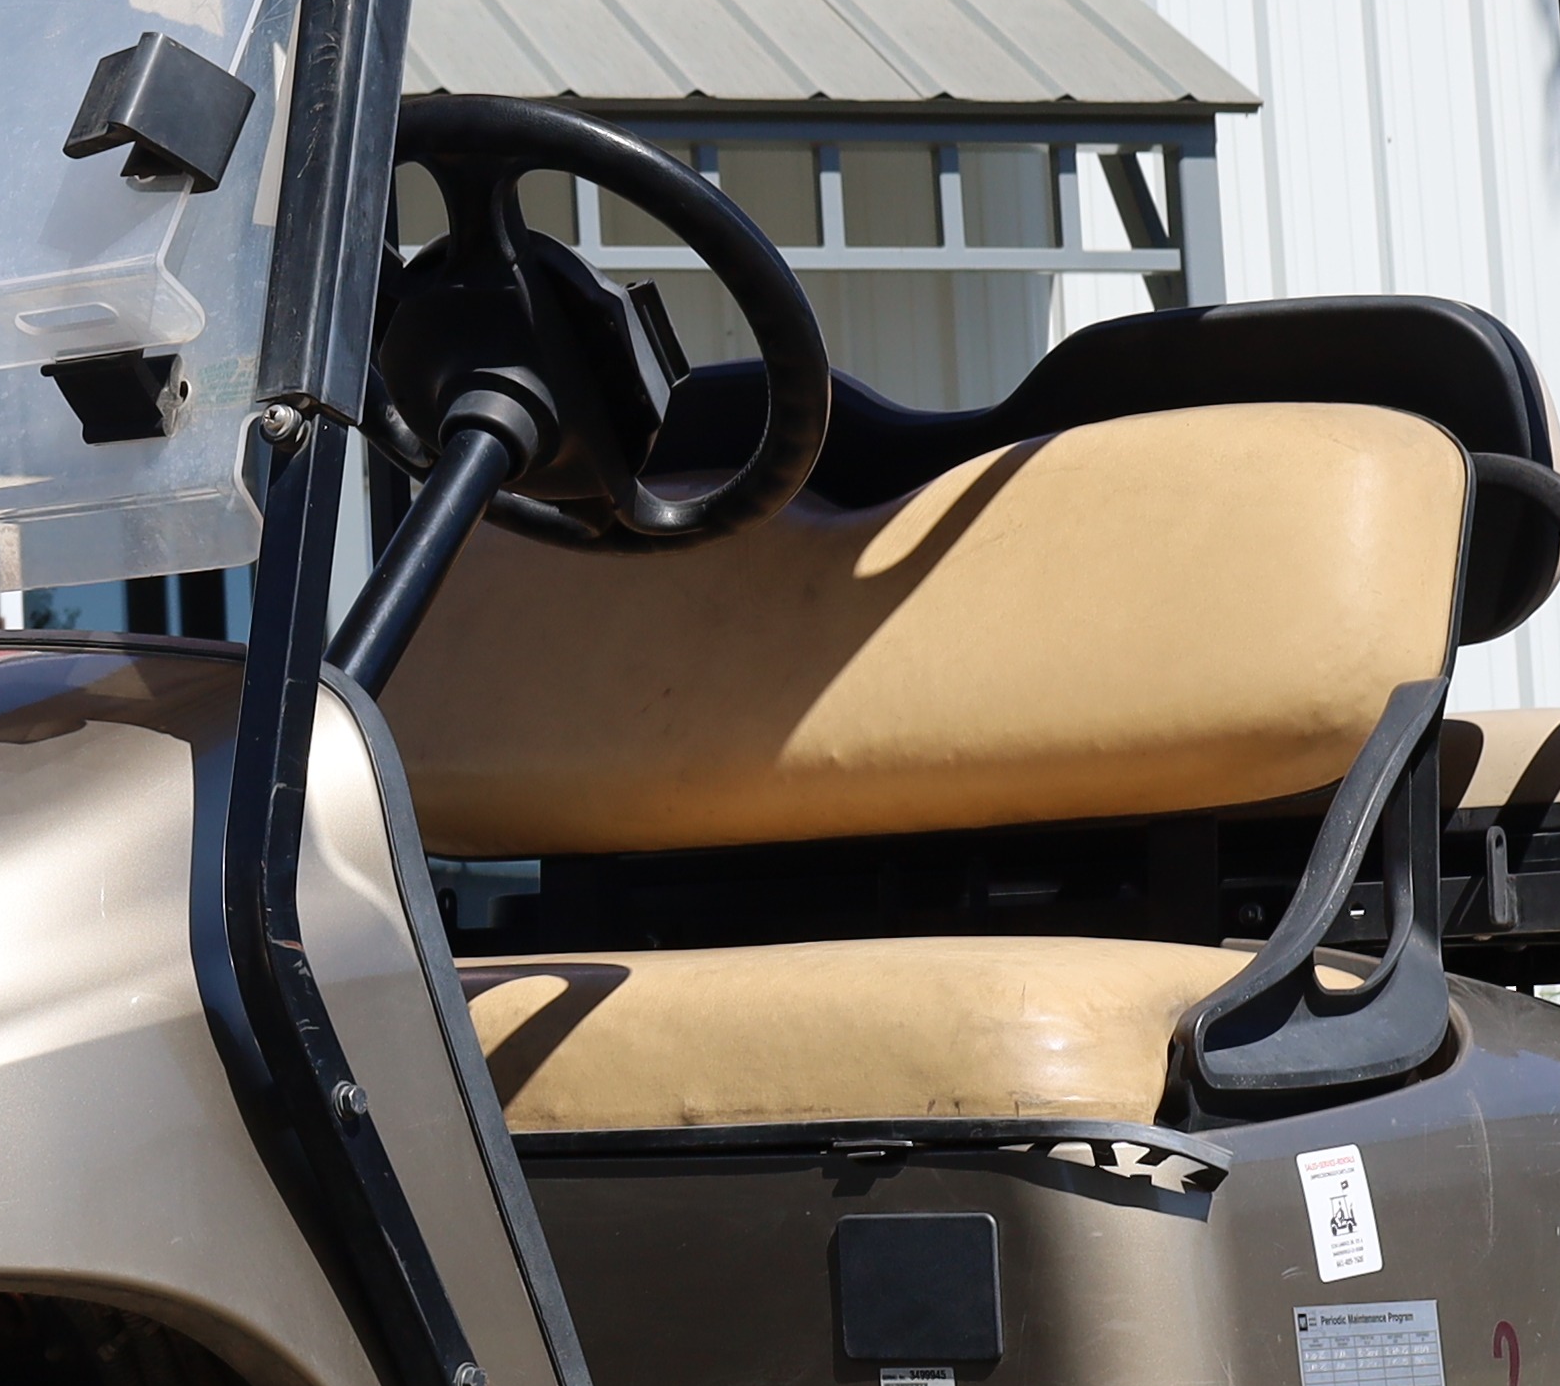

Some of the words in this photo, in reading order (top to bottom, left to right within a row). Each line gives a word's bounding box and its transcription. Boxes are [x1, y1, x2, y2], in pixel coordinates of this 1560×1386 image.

[1320, 1314, 1347, 1326] Periodic
[1348, 1313, 1387, 1325] Maintenance
[1388, 1311, 1414, 1325] Program
